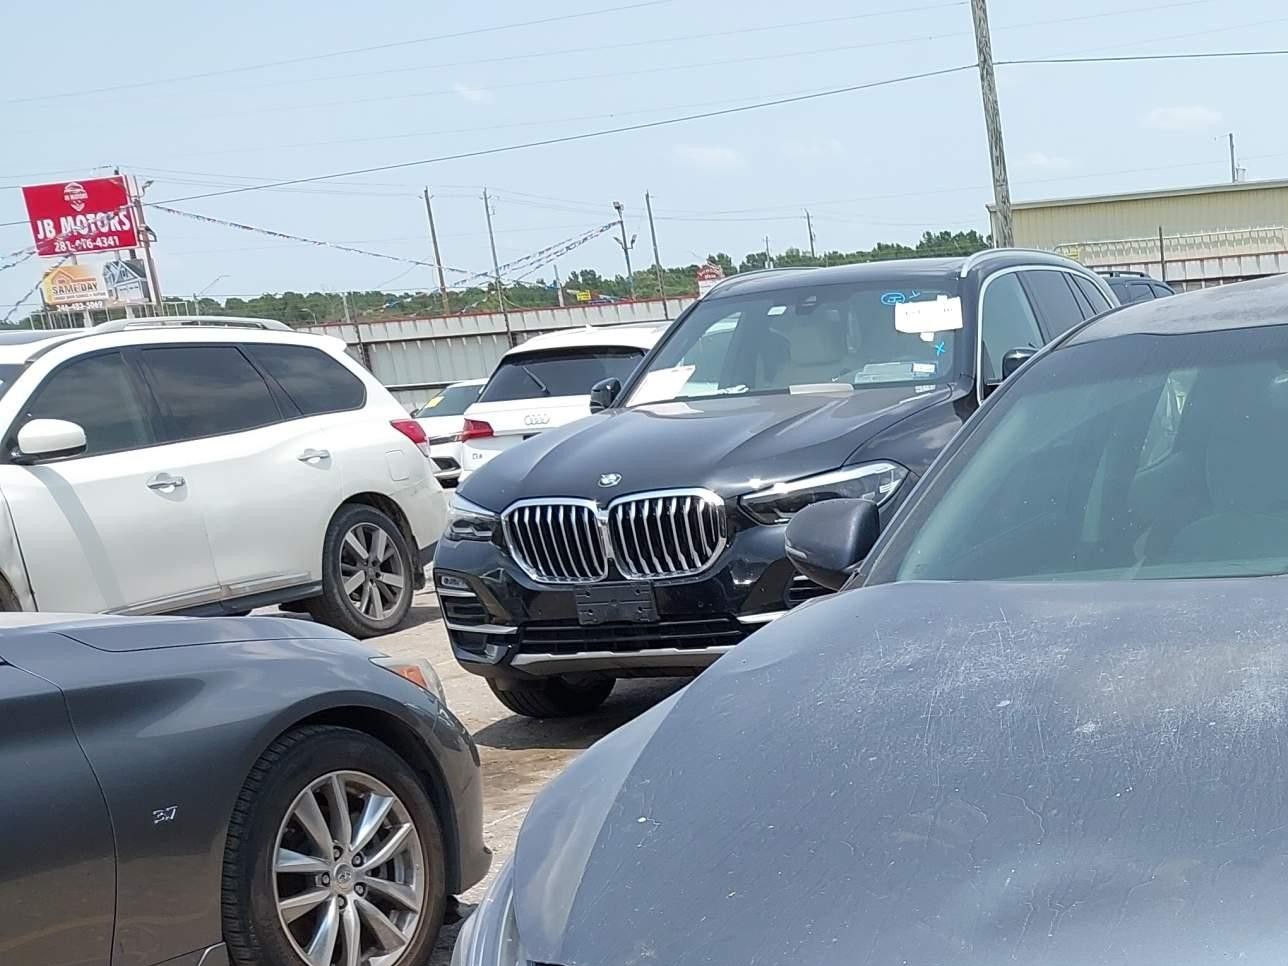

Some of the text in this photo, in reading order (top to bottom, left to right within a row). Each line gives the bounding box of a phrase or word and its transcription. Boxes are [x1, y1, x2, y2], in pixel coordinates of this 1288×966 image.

[37, 210, 131, 240] JB MOTORS
[80, 281, 98, 292] DAY
